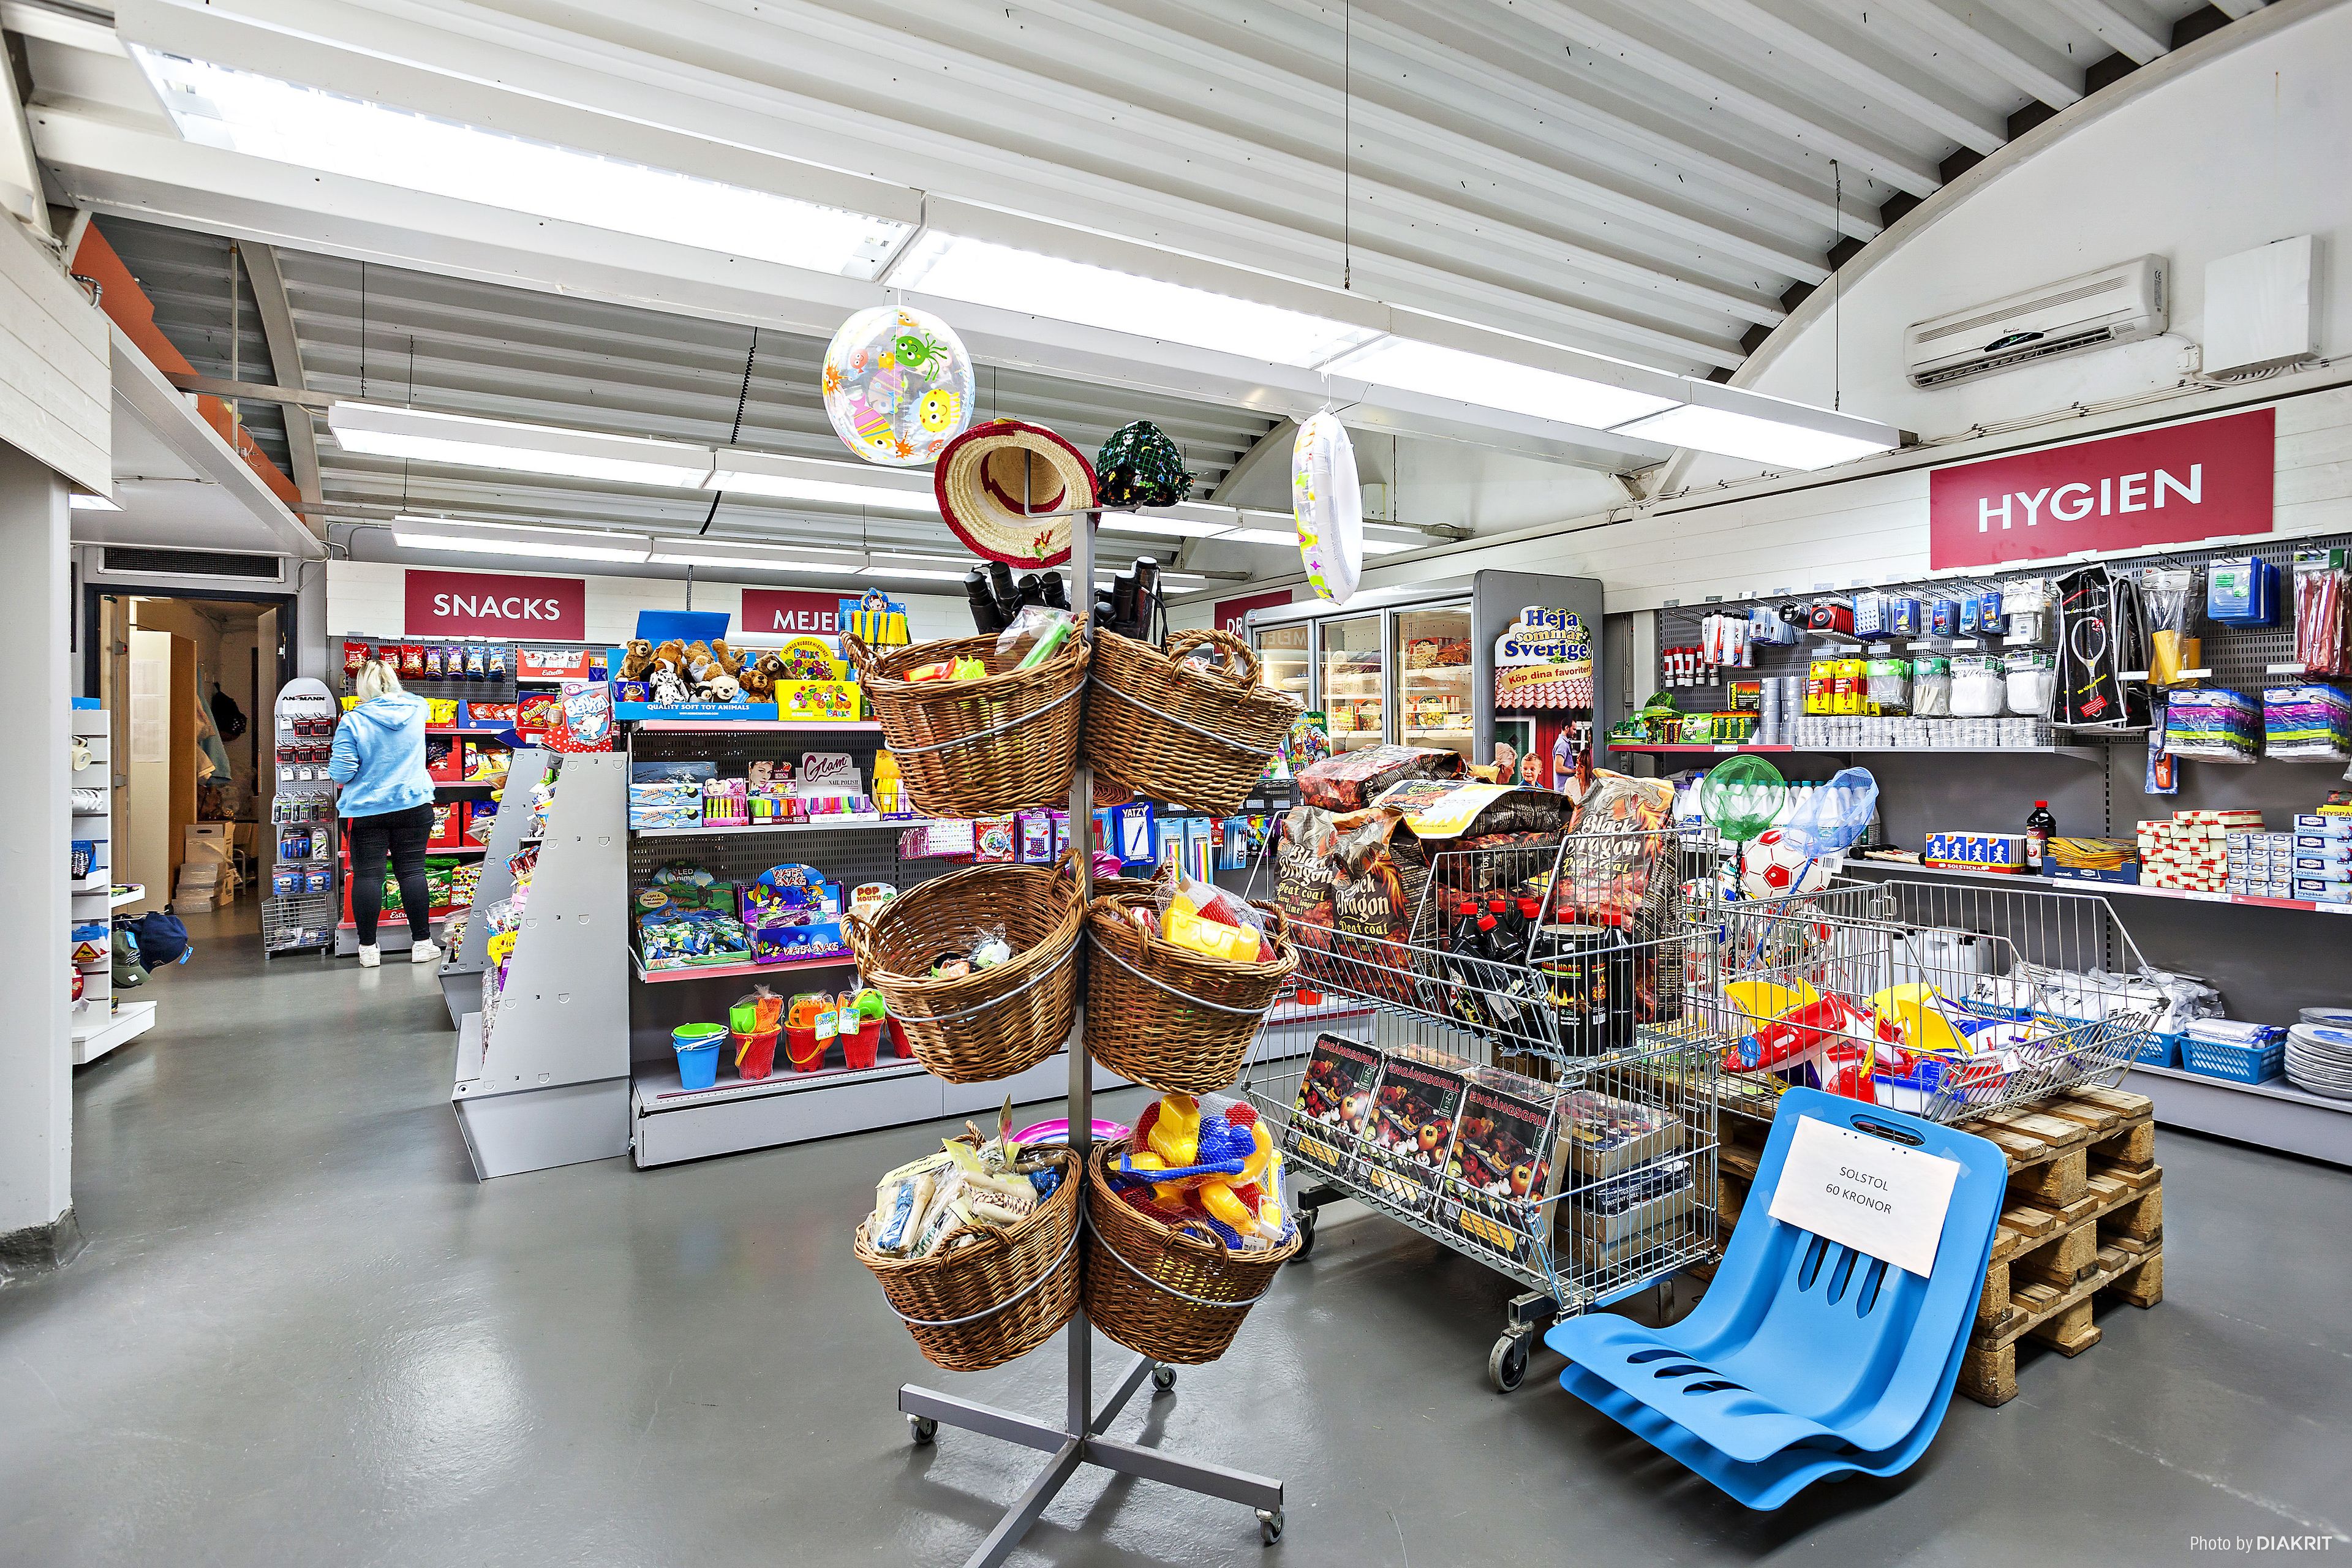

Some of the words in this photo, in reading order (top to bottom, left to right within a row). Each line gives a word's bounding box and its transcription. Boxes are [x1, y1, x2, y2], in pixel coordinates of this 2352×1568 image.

[1978, 463, 2202, 533] HYGIEN
[432, 594, 560, 621] SNACKS
[772, 609, 839, 632] MEJE
[1526, 609, 1578, 630] Heja
[784, 643, 797, 654] SPONGE
[813, 642, 829, 657] HI-BOUNCE
[794, 649, 820, 659] BALLS
[1505, 639, 1591, 660] Sverige!
[1509, 674, 1528, 684] Köp
[1531, 671, 1552, 680] dina
[1555, 665, 1591, 676] favoriter!
[521, 700, 551, 722] Dumle
[600, 734, 611, 742] GUM
[804, 755, 848, 782] Glam
[1122, 805, 1148, 818] YATZY
[1581, 814, 1632, 833] Black
[772, 869, 803, 878] WATER
[774, 876, 806, 886] SNAKE
[1280, 856, 1333, 886] Dragon
[857, 886, 880, 895] POP
[1277, 882, 1299, 895] Peat
[1302, 889, 1325, 902] coal
[1278, 895, 1290, 903] burns
[1290, 895, 1300, 905] 3X
[1300, 899, 1316, 909] longer
[1286, 904, 1303, 914] time!
[1336, 891, 1390, 922] Dragon
[1365, 923, 1389, 935] coal
[783, 944, 810, 956] WATER
[811, 942, 839, 952] SNAKE
[1318, 1040, 1379, 1067] ENGÅNGSGRILL
[1389, 1064, 1461, 1093] ENGÅNGSGRILL
[1839, 1167, 1889, 1191] SOLSTOL
[1826, 1183, 1839, 1196] 60
[1842, 1189, 1891, 1214] KRONOR
